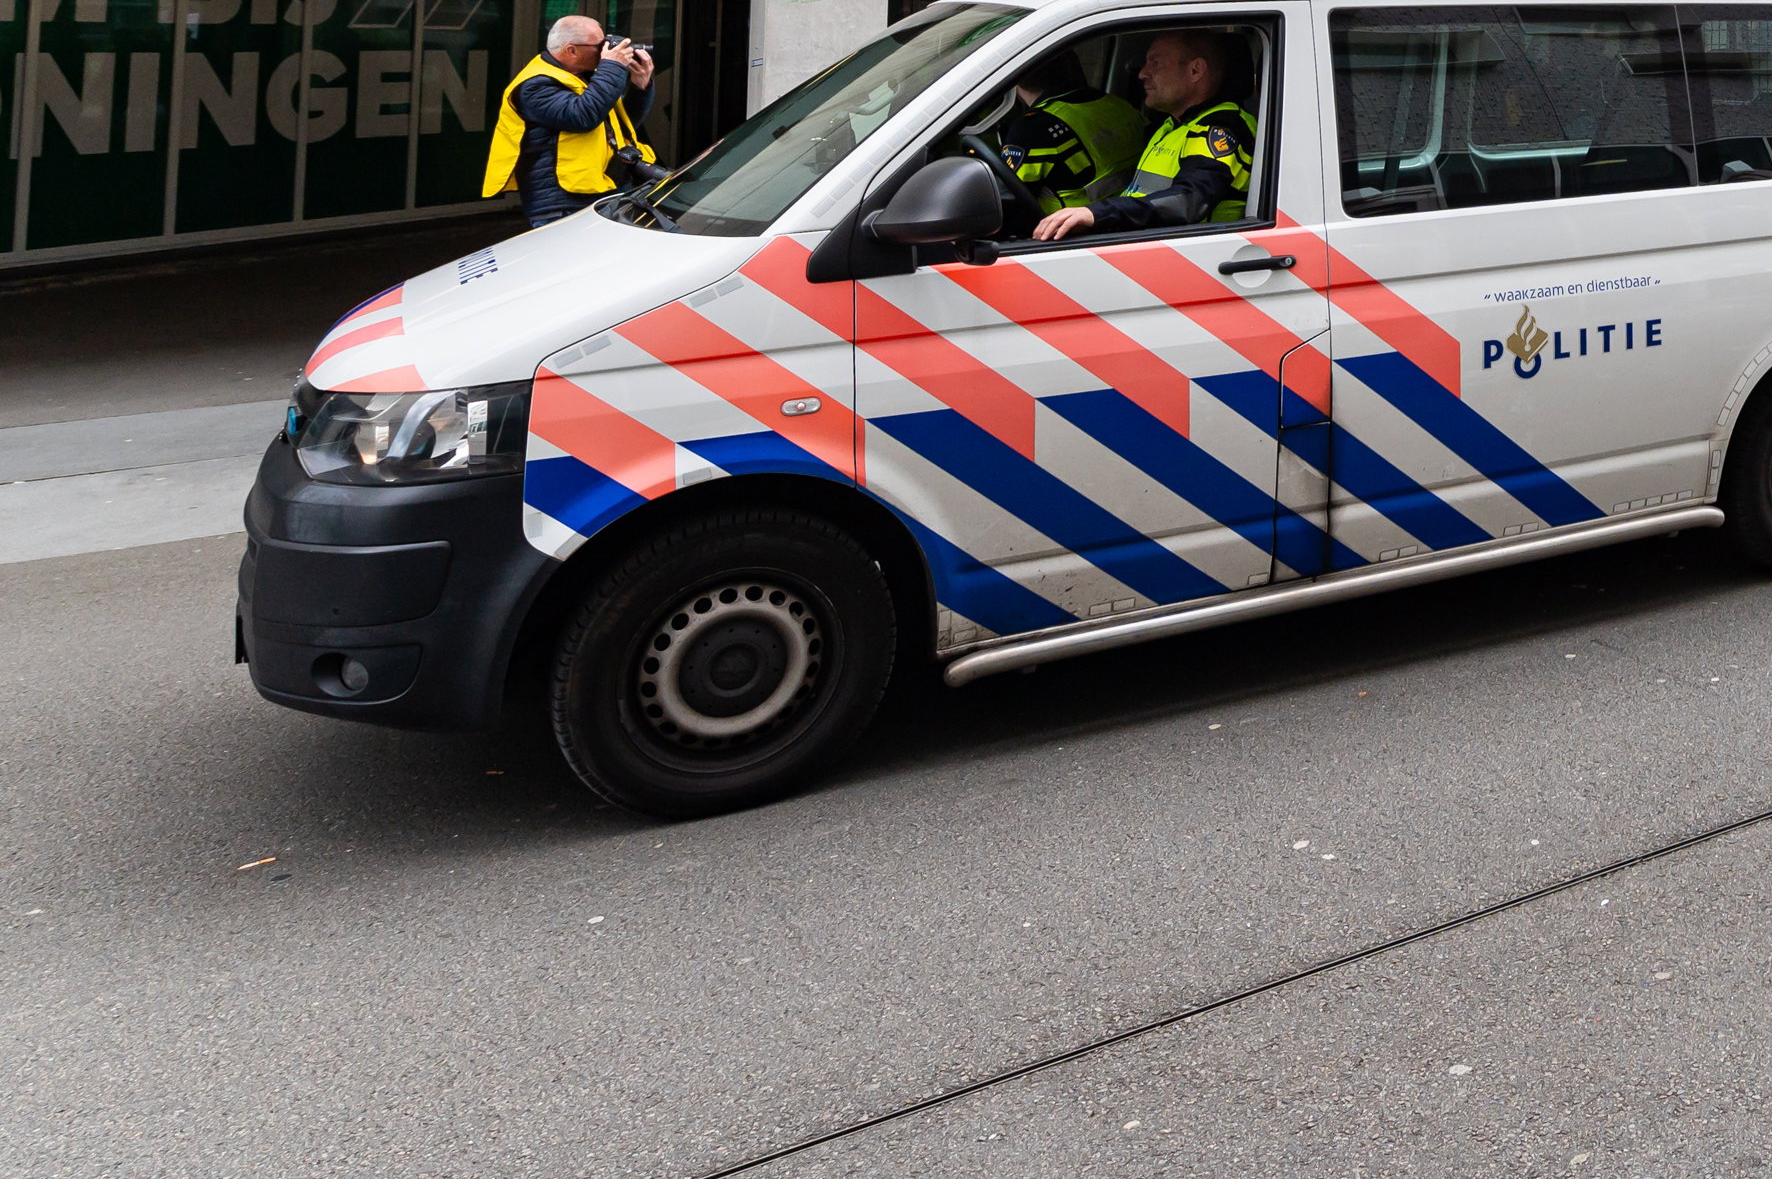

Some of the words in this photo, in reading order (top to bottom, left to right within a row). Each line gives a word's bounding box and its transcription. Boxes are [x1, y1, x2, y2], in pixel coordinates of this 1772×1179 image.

[0, 50, 489, 160] NINGEN
[1494, 285, 1564, 303] waakzaam
[1567, 283, 1583, 295] en
[1586, 275, 1651, 292] dienstbaar
[1482, 318, 1662, 379] POLITIE
